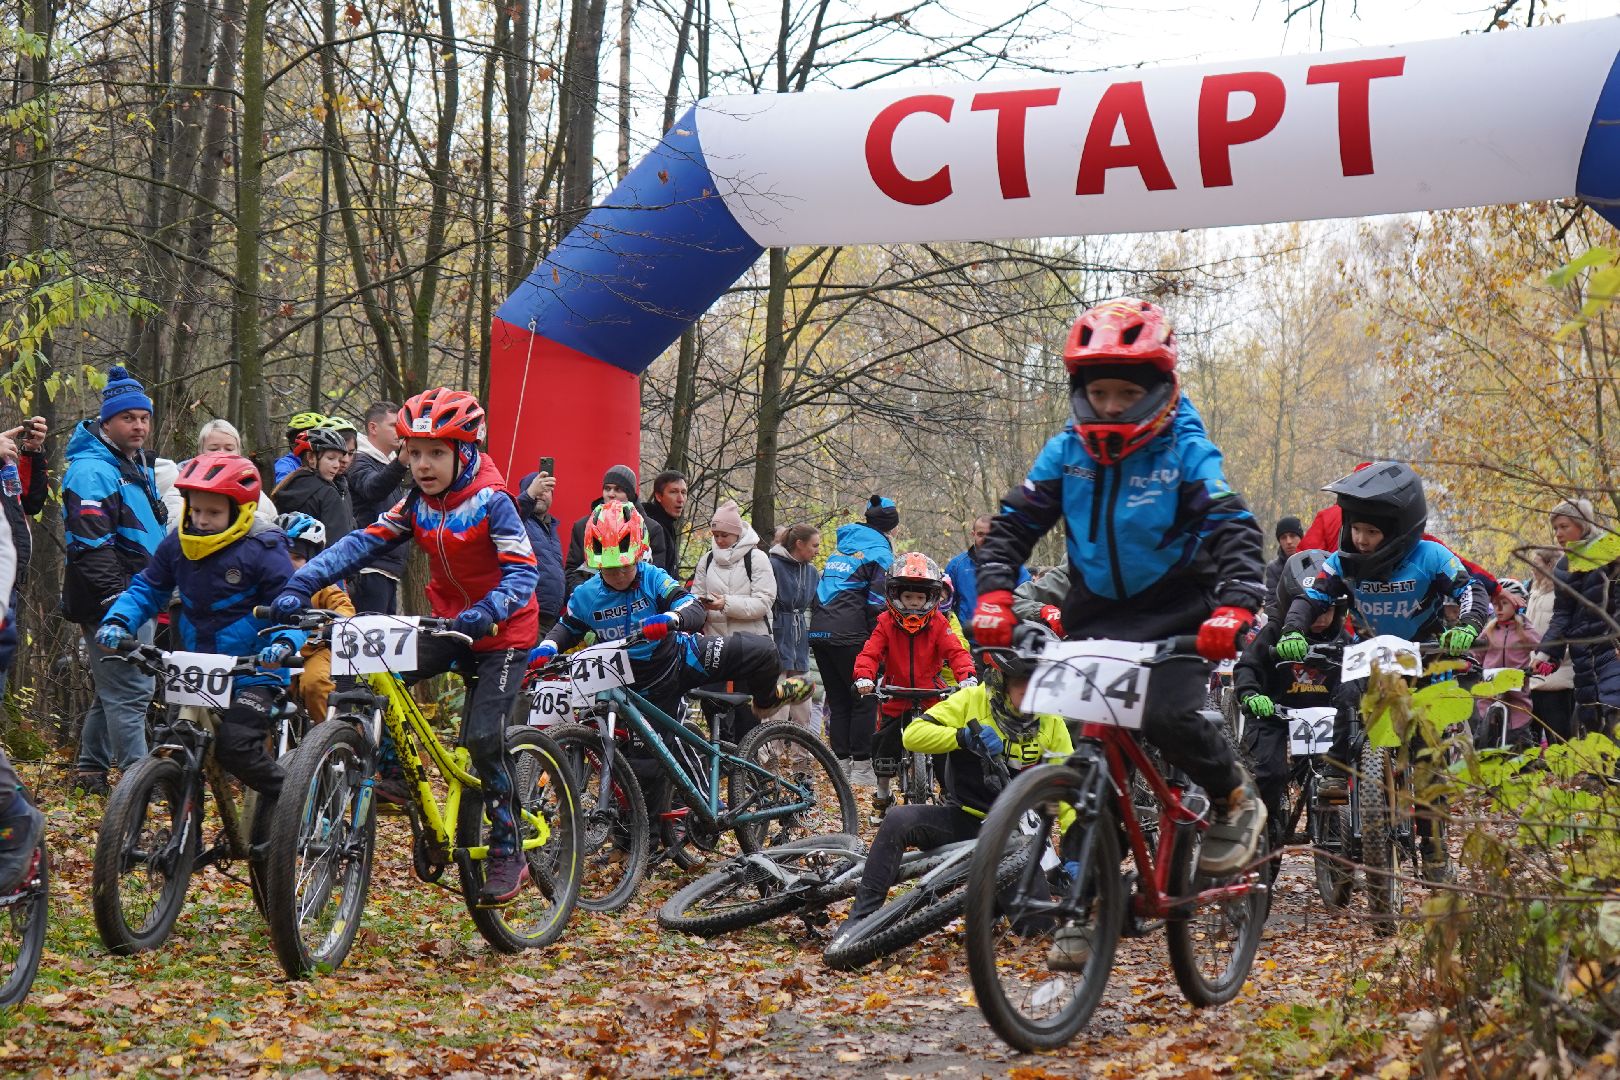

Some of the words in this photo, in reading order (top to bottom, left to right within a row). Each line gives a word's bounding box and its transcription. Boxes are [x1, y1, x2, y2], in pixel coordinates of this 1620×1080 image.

[864, 56, 1405, 206] СТАРТ
[1361, 579, 1416, 594] RUSFIT
[603, 597, 650, 620] RUSFIT
[335, 627, 414, 660] 387
[167, 663, 230, 696] 290
[572, 651, 626, 683] 411
[1034, 662, 1142, 710] 414
[530, 692, 571, 716] 405
